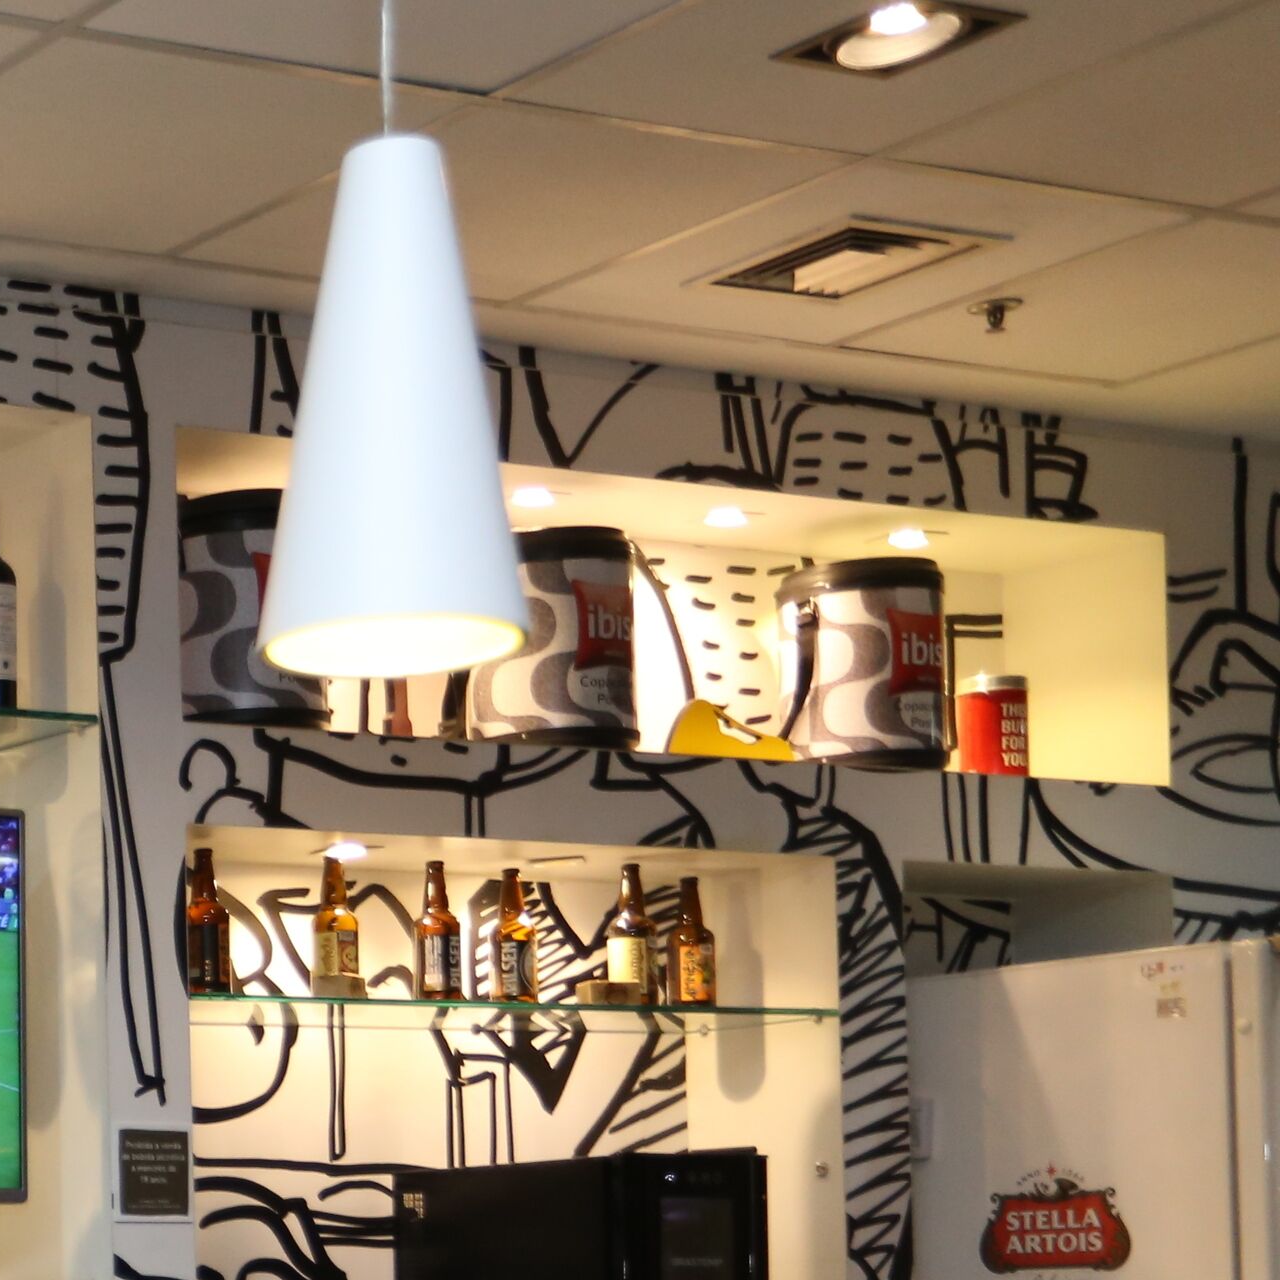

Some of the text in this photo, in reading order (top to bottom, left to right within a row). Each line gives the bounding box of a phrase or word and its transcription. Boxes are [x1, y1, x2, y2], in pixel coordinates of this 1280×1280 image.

[587, 604, 631, 641] ibis
[901, 632, 943, 666] ibis
[501, 941, 518, 997] PILSEN
[1006, 1207, 1102, 1231] STELLA
[1006, 1231, 1104, 1254] ARTOIS
